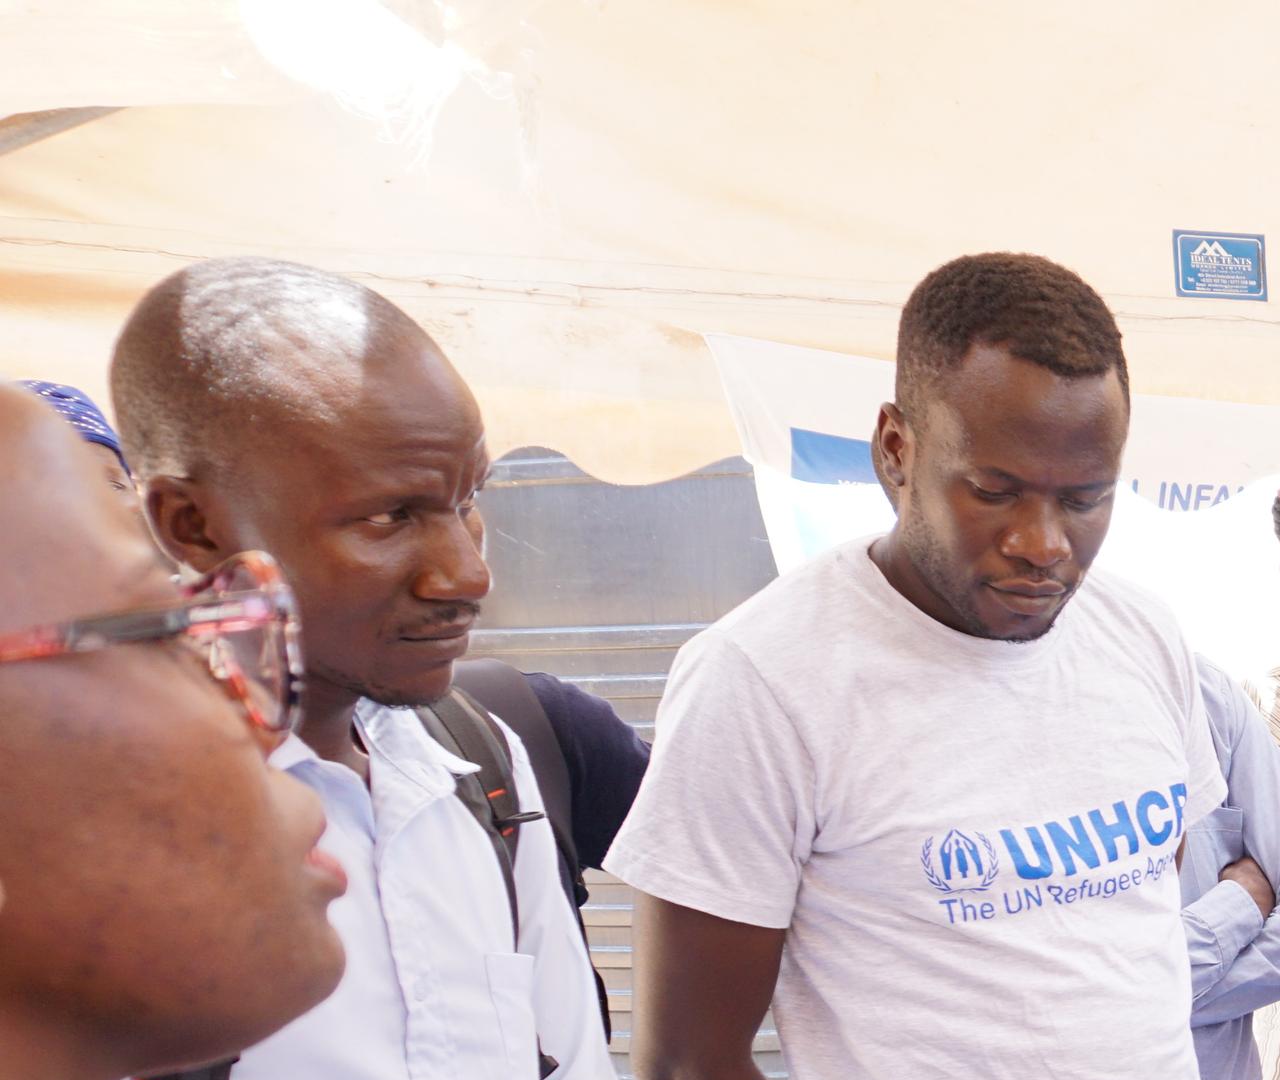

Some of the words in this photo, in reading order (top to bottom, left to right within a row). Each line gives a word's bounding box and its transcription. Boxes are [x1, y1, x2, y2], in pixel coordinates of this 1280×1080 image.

[1220, 256, 1252, 265] TENTS
[939, 898, 996, 924] The
[1003, 884, 1043, 915] UN
[1047, 867, 1144, 906] Refugee
